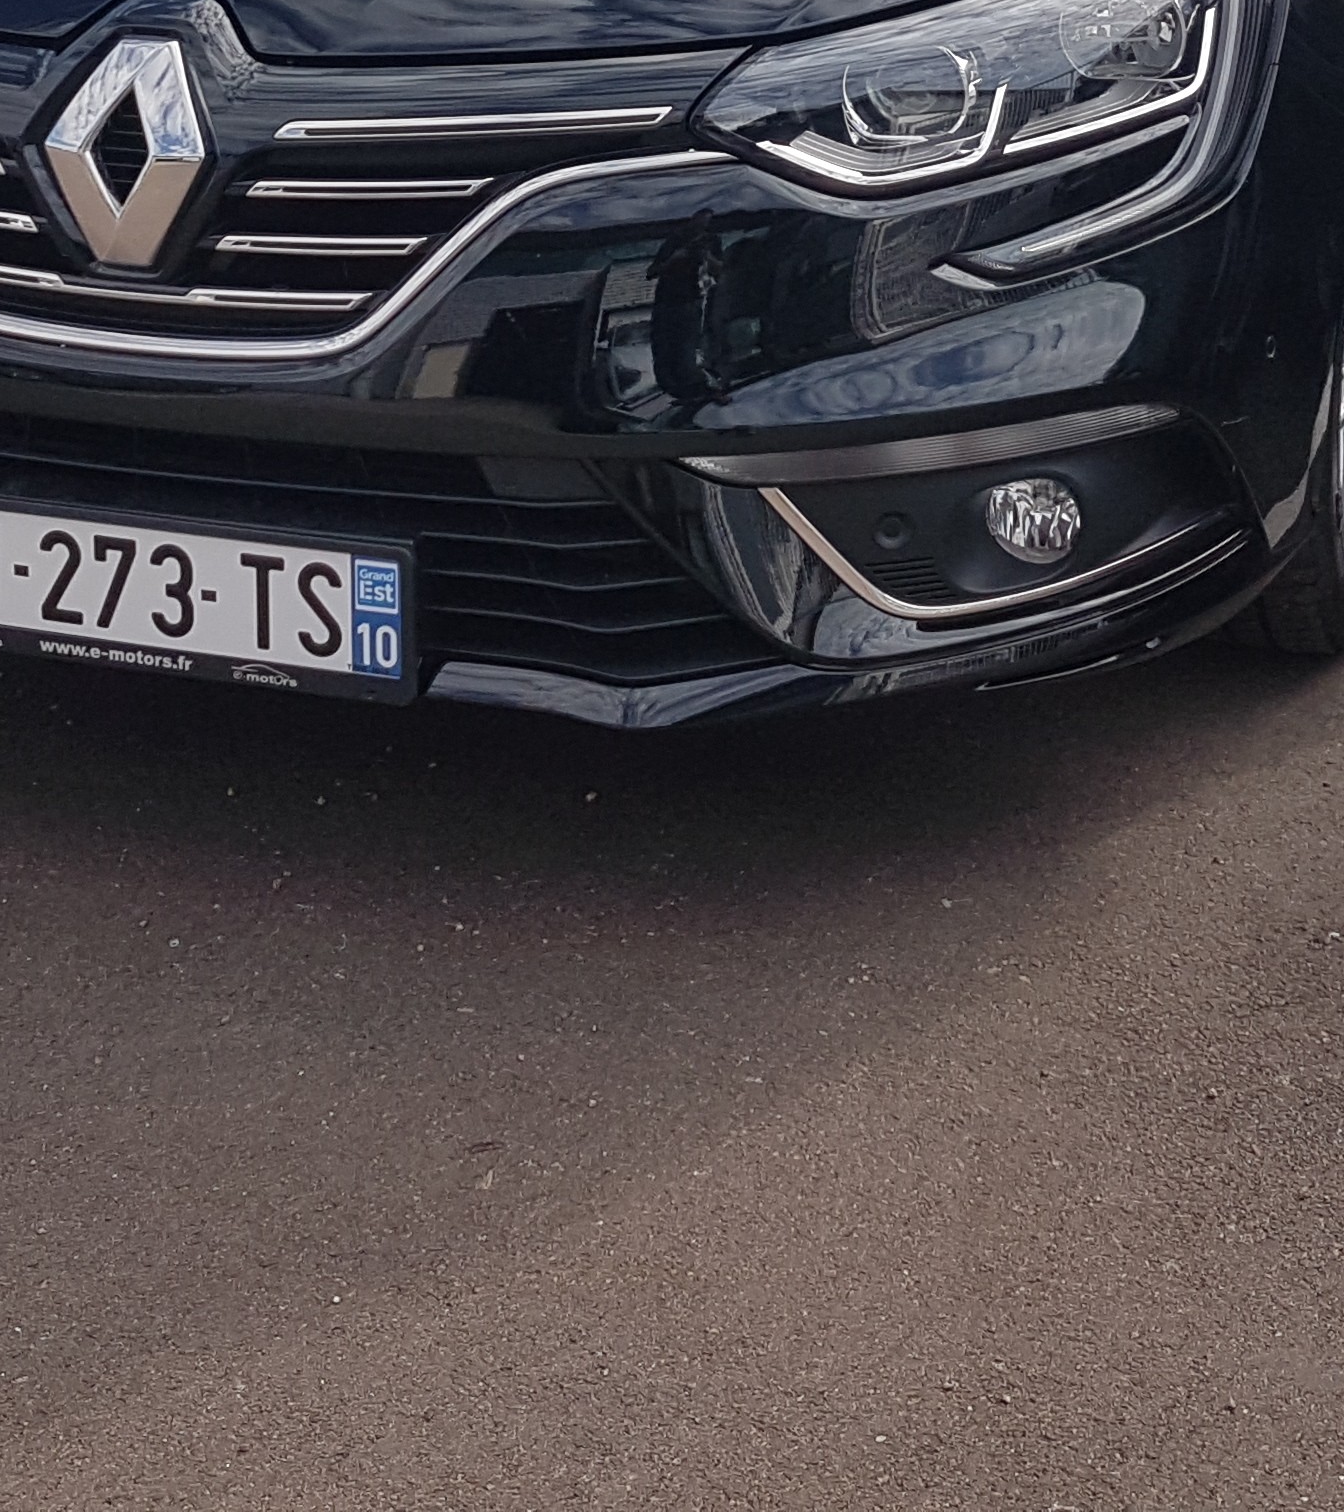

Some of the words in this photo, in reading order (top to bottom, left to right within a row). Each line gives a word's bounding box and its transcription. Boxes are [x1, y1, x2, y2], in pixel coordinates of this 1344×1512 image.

[359, 568, 394, 582] Grand
[359, 580, 394, 603] Est
[40, 640, 193, 672] www.e-motors.fr
[357, 622, 398, 668] 10
